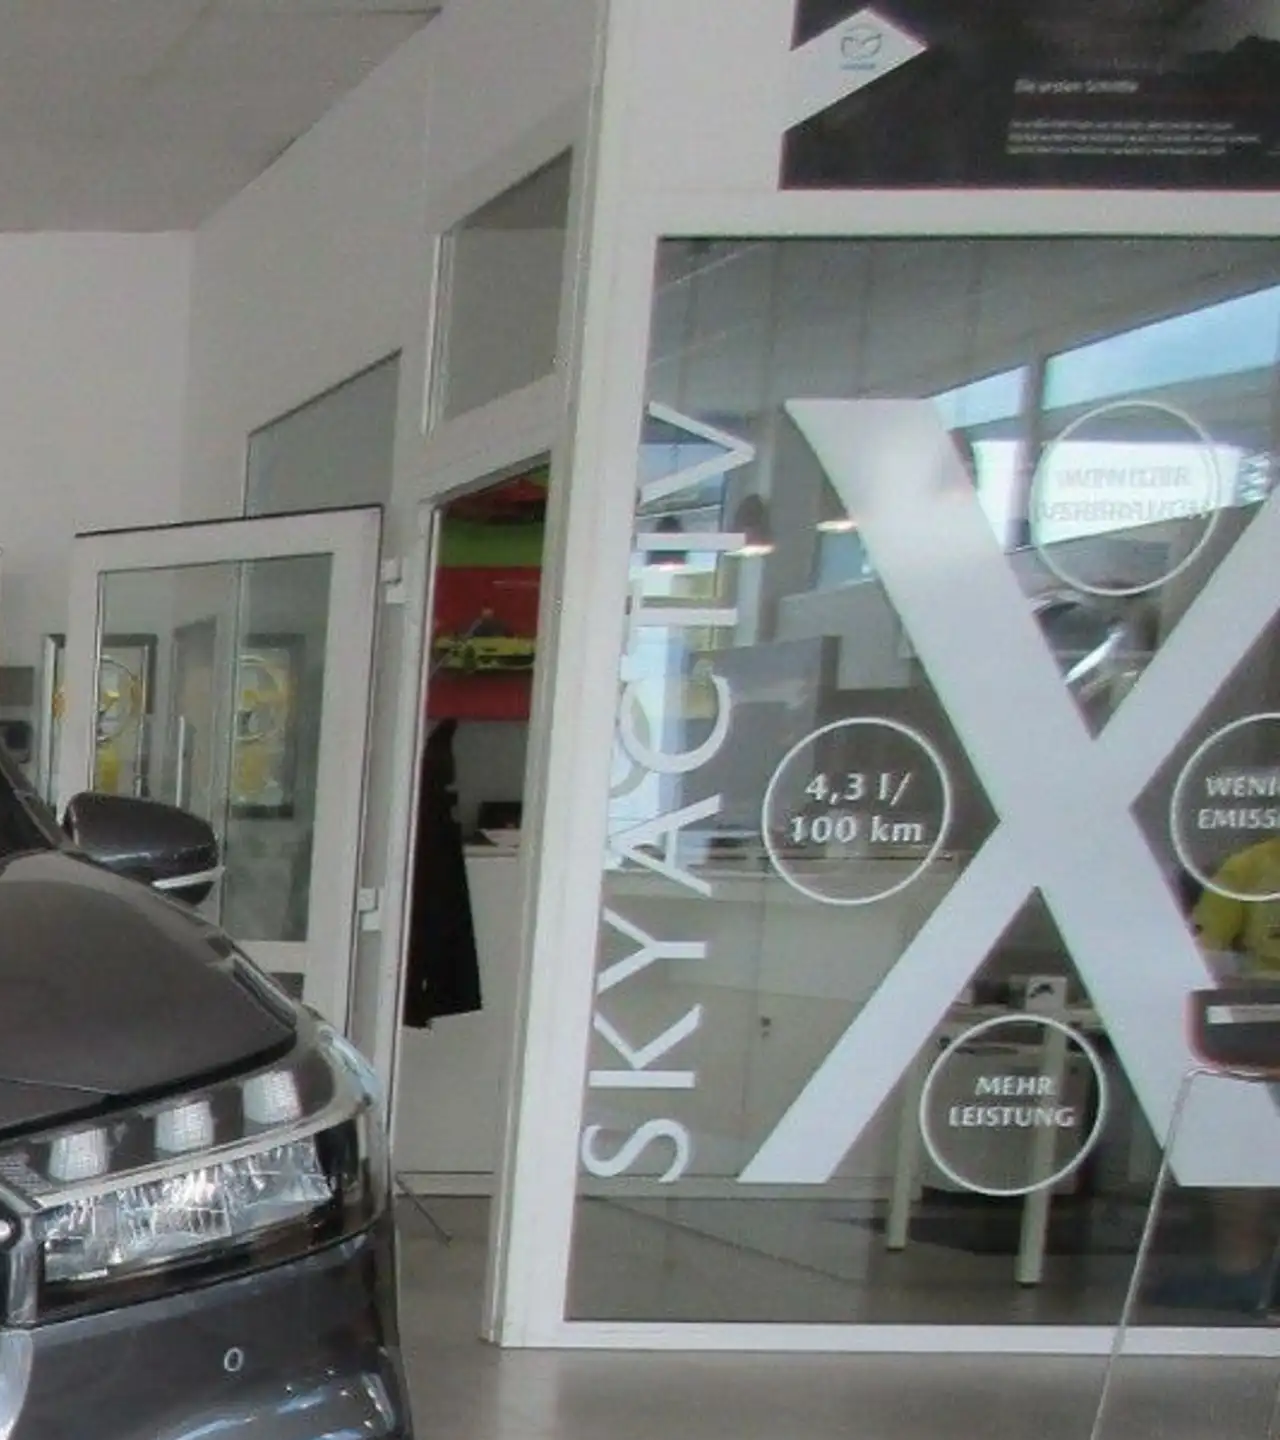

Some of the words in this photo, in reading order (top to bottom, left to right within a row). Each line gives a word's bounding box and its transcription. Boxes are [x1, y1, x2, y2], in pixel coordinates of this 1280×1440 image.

[804, 772, 865, 805] 4,3
[1205, 775, 1280, 798] WENI
[791, 814, 858, 844] 100
[870, 814, 924, 843] km
[975, 1074, 1057, 1097] MEHR
[948, 1105, 1077, 1128] LEISTUNG
